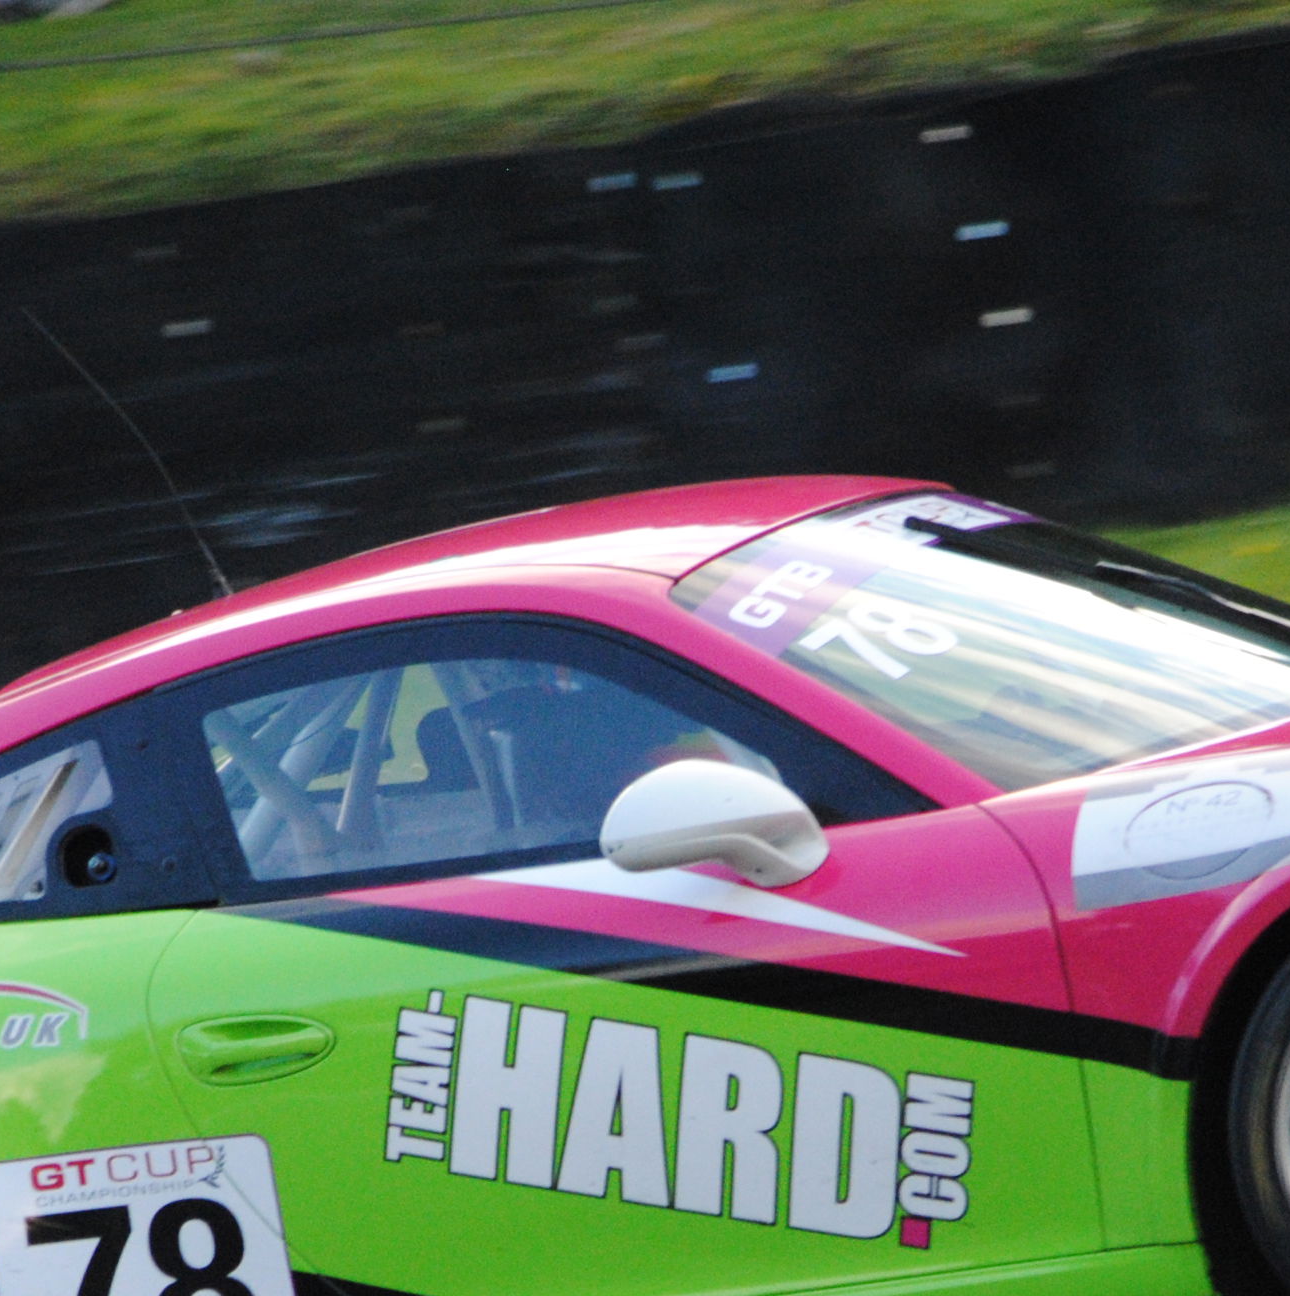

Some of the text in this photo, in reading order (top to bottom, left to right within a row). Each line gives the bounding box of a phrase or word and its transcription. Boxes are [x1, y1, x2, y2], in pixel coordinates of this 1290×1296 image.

[728, 560, 834, 628] GTB
[797, 598, 958, 680] 78
[383, 989, 458, 1163] TEAM-
[447, 993, 902, 1241] HARD
[31, 1145, 214, 1191] GT CUP
[35, 1180, 196, 1208] CHAMPIONSHIP
